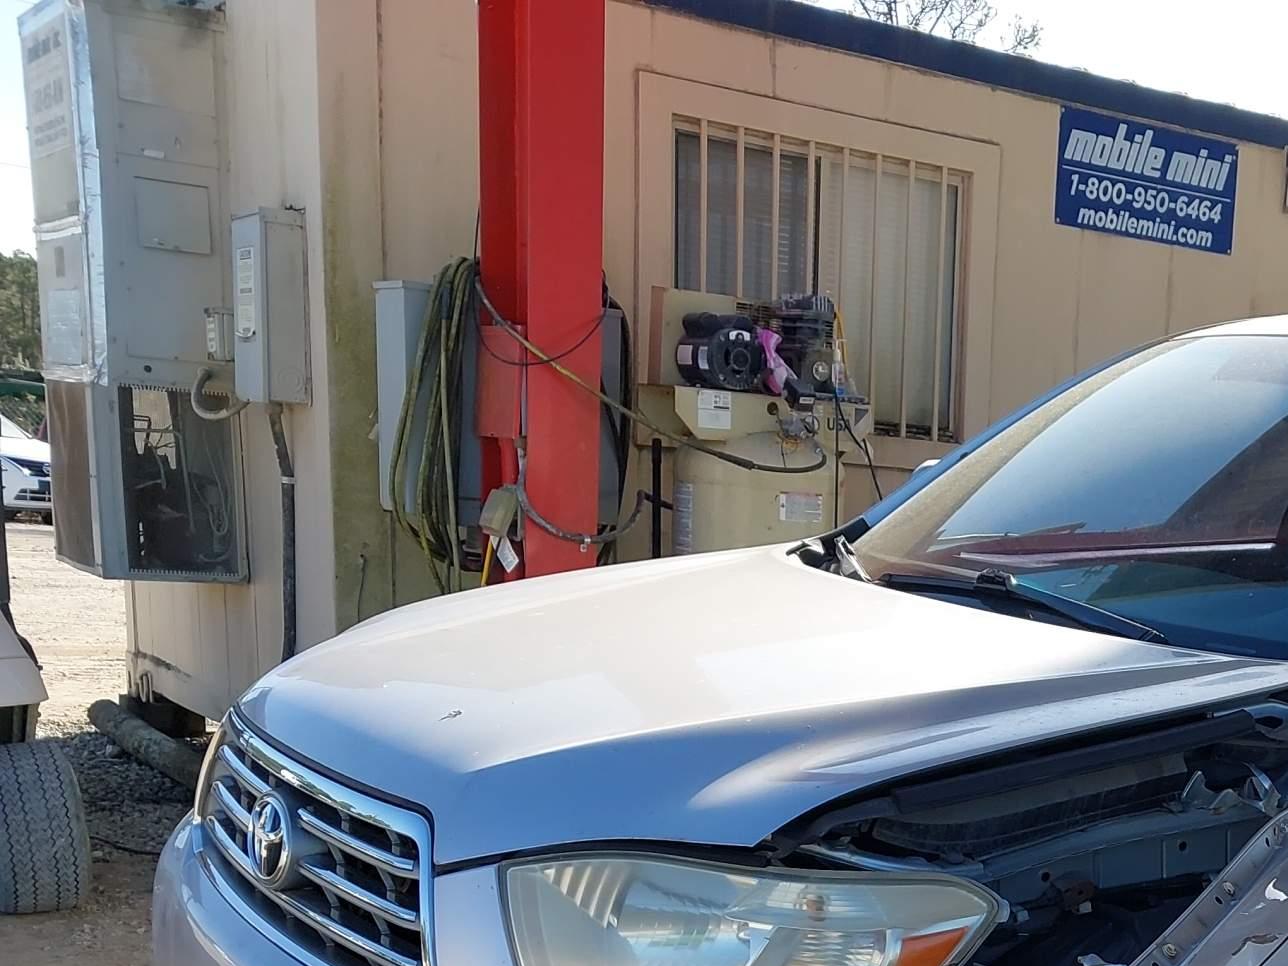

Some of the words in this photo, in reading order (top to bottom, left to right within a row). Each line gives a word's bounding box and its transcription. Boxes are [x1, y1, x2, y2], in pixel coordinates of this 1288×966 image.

[1063, 123, 1166, 178] mobile
[1166, 149, 1233, 191] mini
[1070, 174, 1222, 224] 1-800-950-6464
[1077, 207, 1213, 247] mobilemini.com
